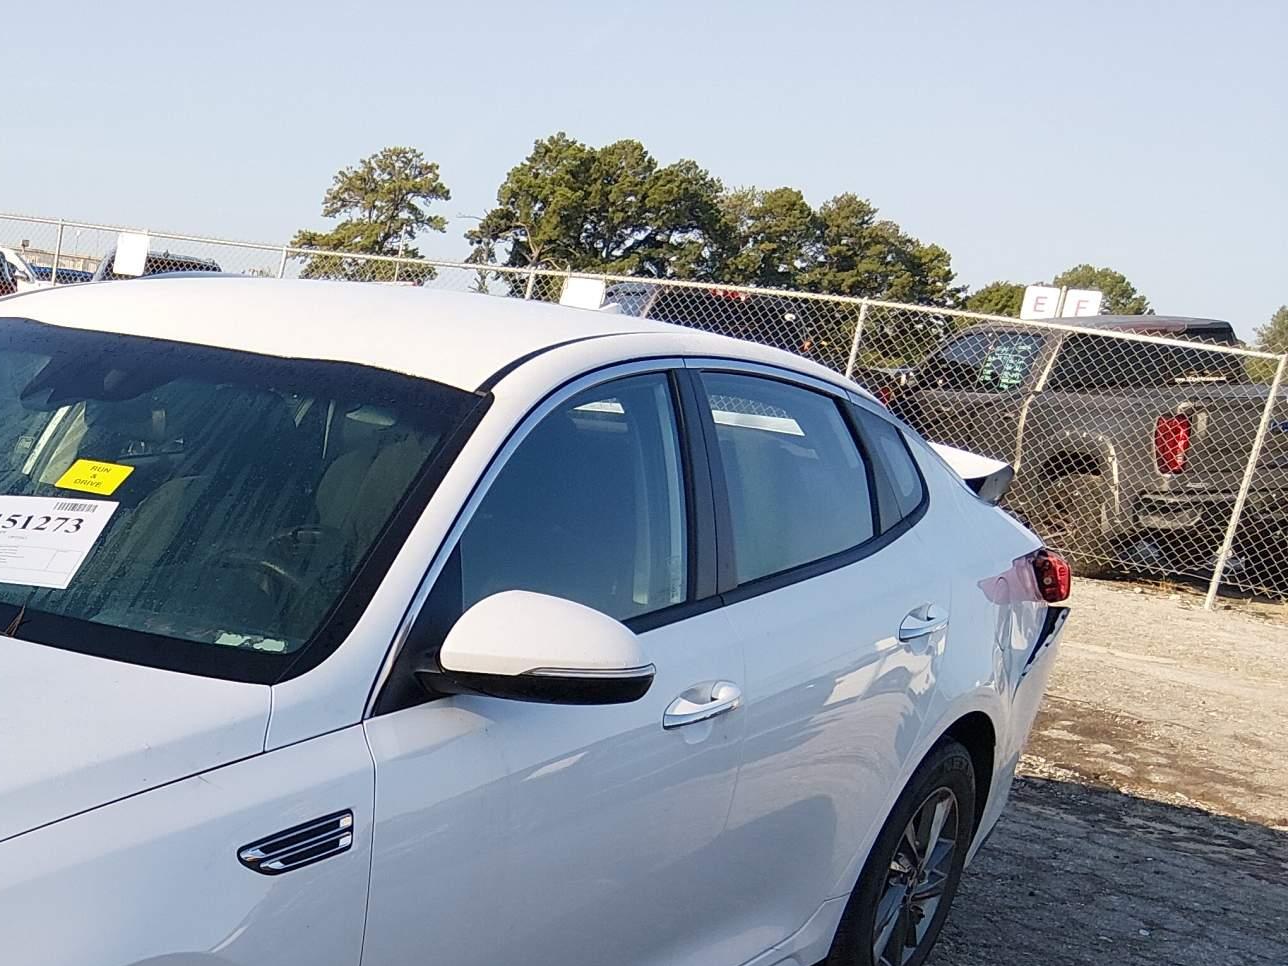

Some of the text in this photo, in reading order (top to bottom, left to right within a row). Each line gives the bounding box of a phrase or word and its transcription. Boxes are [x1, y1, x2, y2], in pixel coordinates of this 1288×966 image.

[1032, 296, 1048, 312] E
[1074, 299, 1089, 316] F
[89, 465, 112, 473] RUN
[73, 478, 103, 487] DRIVE
